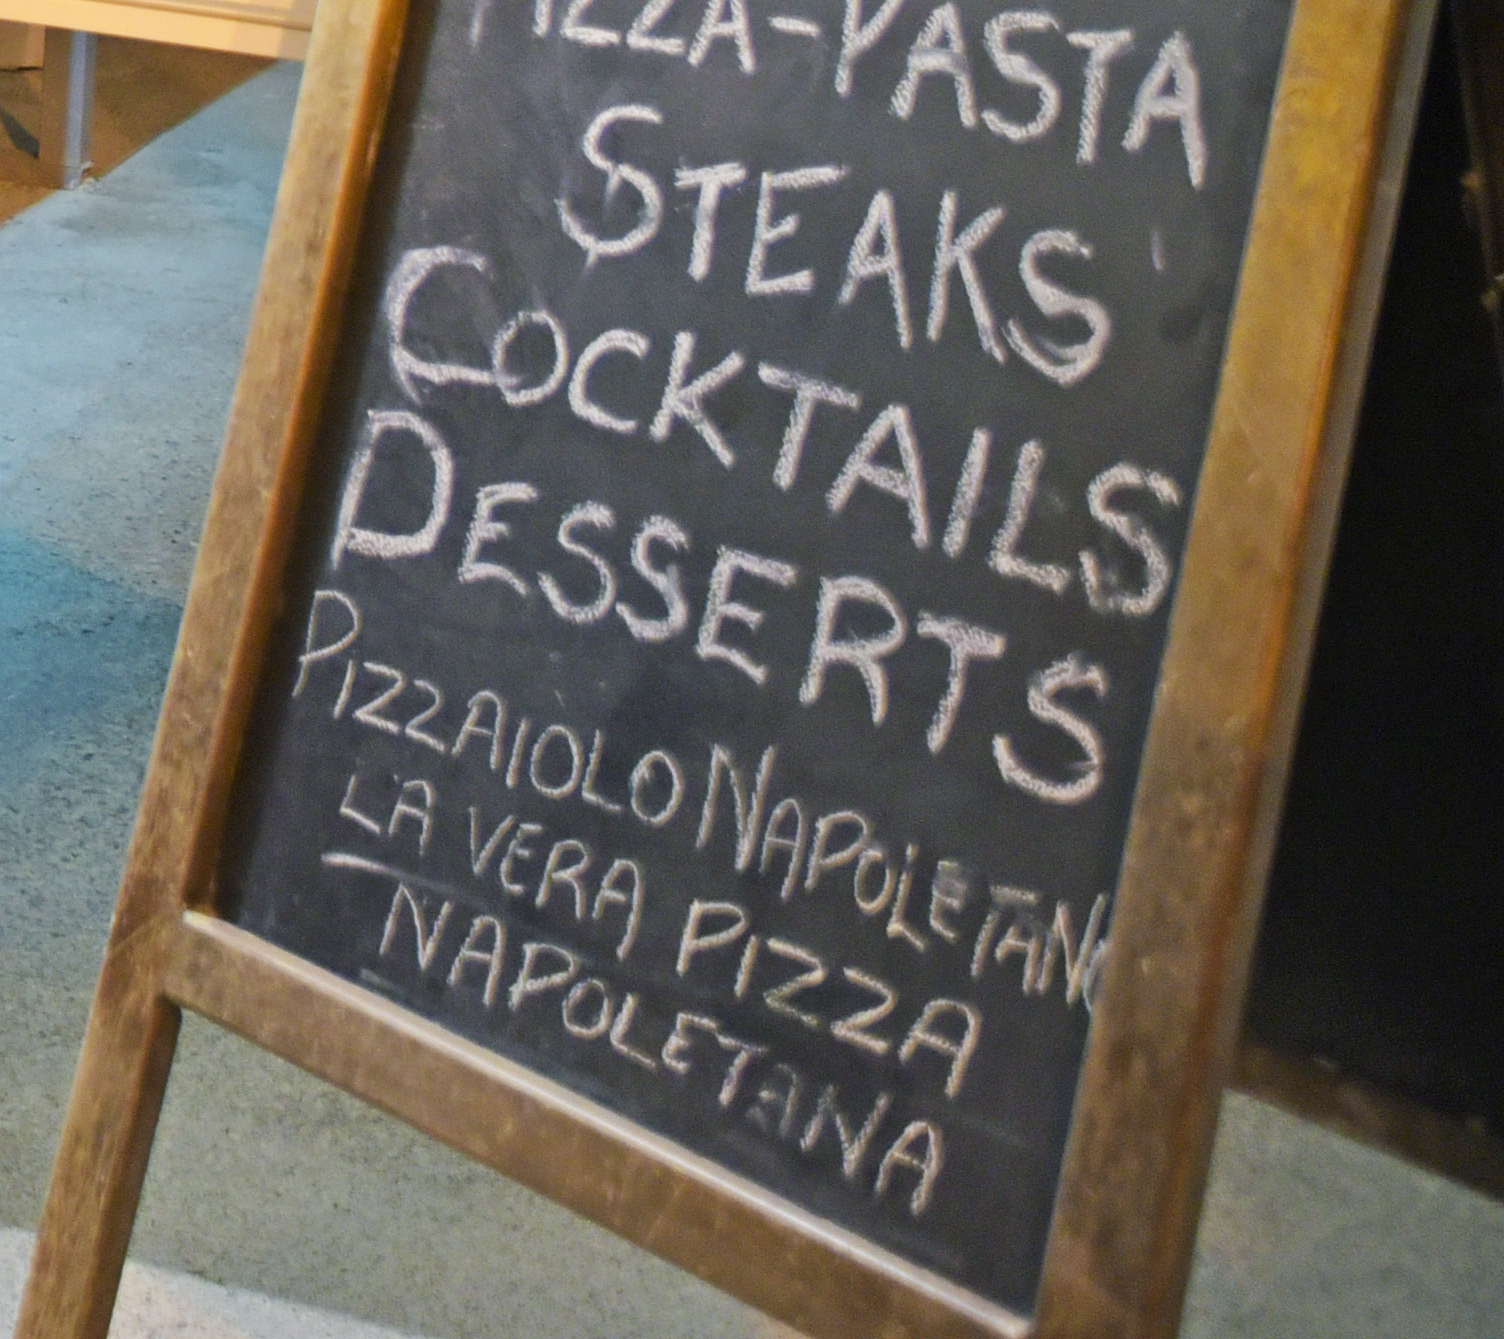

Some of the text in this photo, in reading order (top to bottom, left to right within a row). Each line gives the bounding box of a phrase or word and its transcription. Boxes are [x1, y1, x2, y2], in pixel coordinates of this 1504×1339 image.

[383, 244, 1183, 617] COCKTAILS
[554, 103, 1111, 385] STEAKS
[329, 408, 1108, 806] DESSERTS
[291, 588, 1110, 1017] PIZZAIOLO NAPOLETAN
[337, 772, 983, 1100] LA VERA PIZZA
